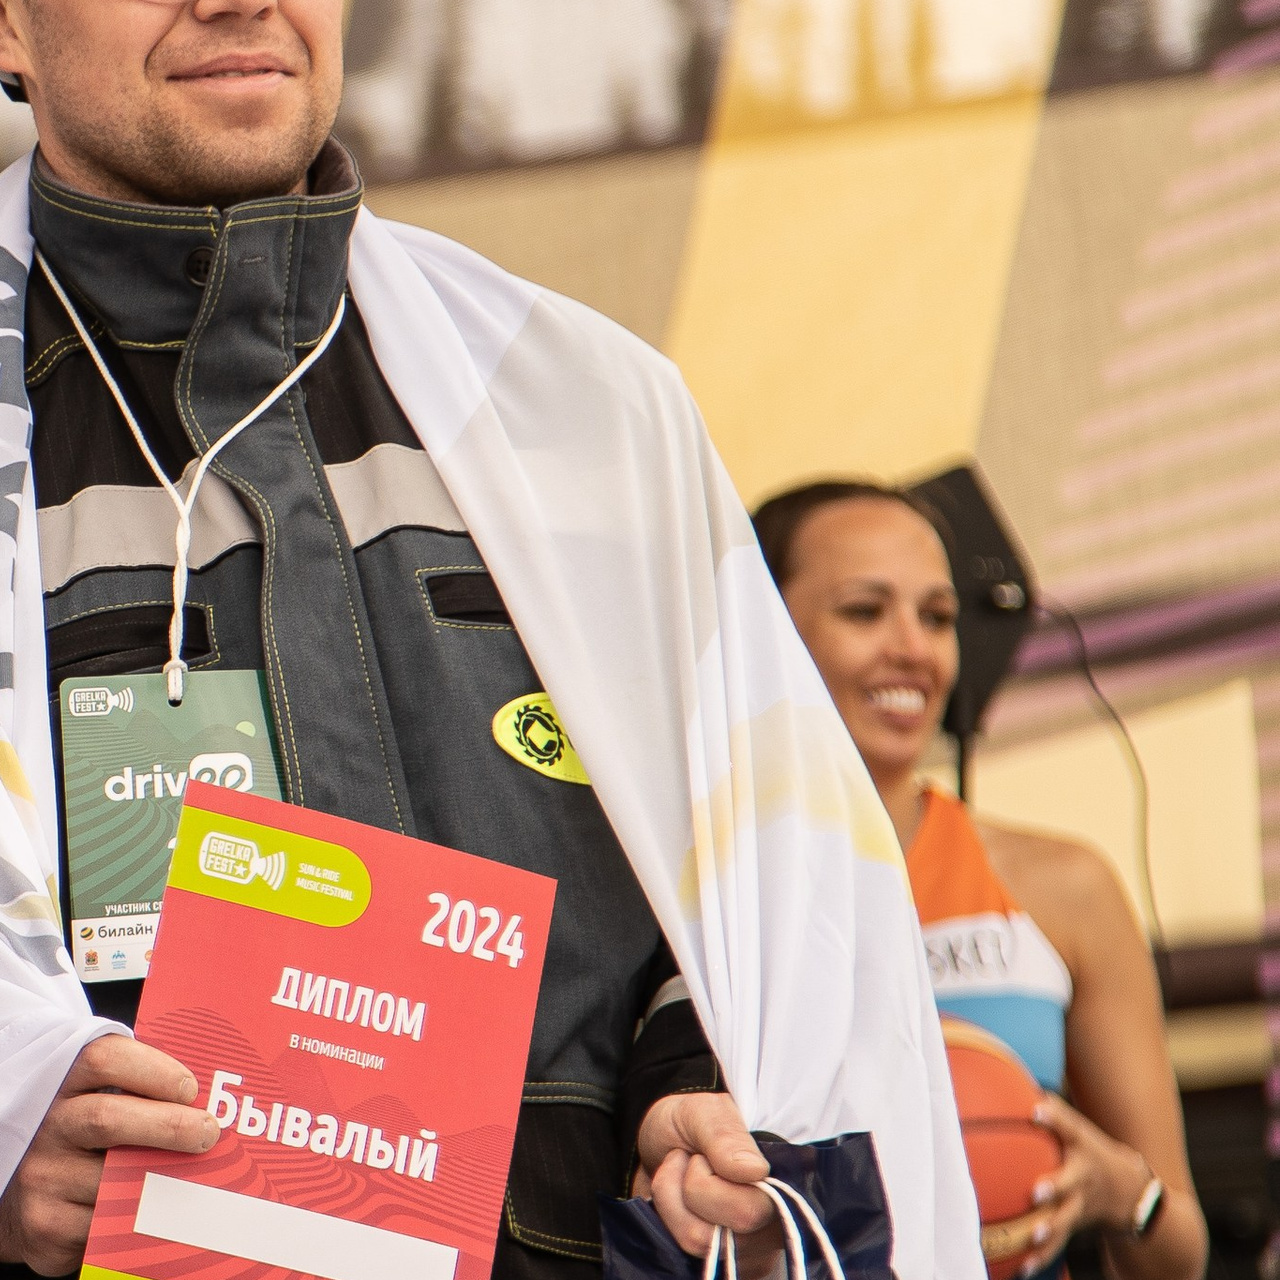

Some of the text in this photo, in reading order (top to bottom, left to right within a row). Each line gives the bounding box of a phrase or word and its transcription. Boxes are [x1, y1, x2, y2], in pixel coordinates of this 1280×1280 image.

[75, 702, 97, 713] FEST
[206, 854, 236, 872] FEST
[296, 877, 354, 901] MUSIC FESTIVAL
[105, 902, 151, 916] УЧАСТНИК
[98, 923, 153, 939] билайн
[421, 892, 525, 969] 2024
[270, 966, 426, 1042] ДИПЛОМ
[301, 1037, 385, 1071] номинации
[206, 1069, 439, 1183] Бывалый
